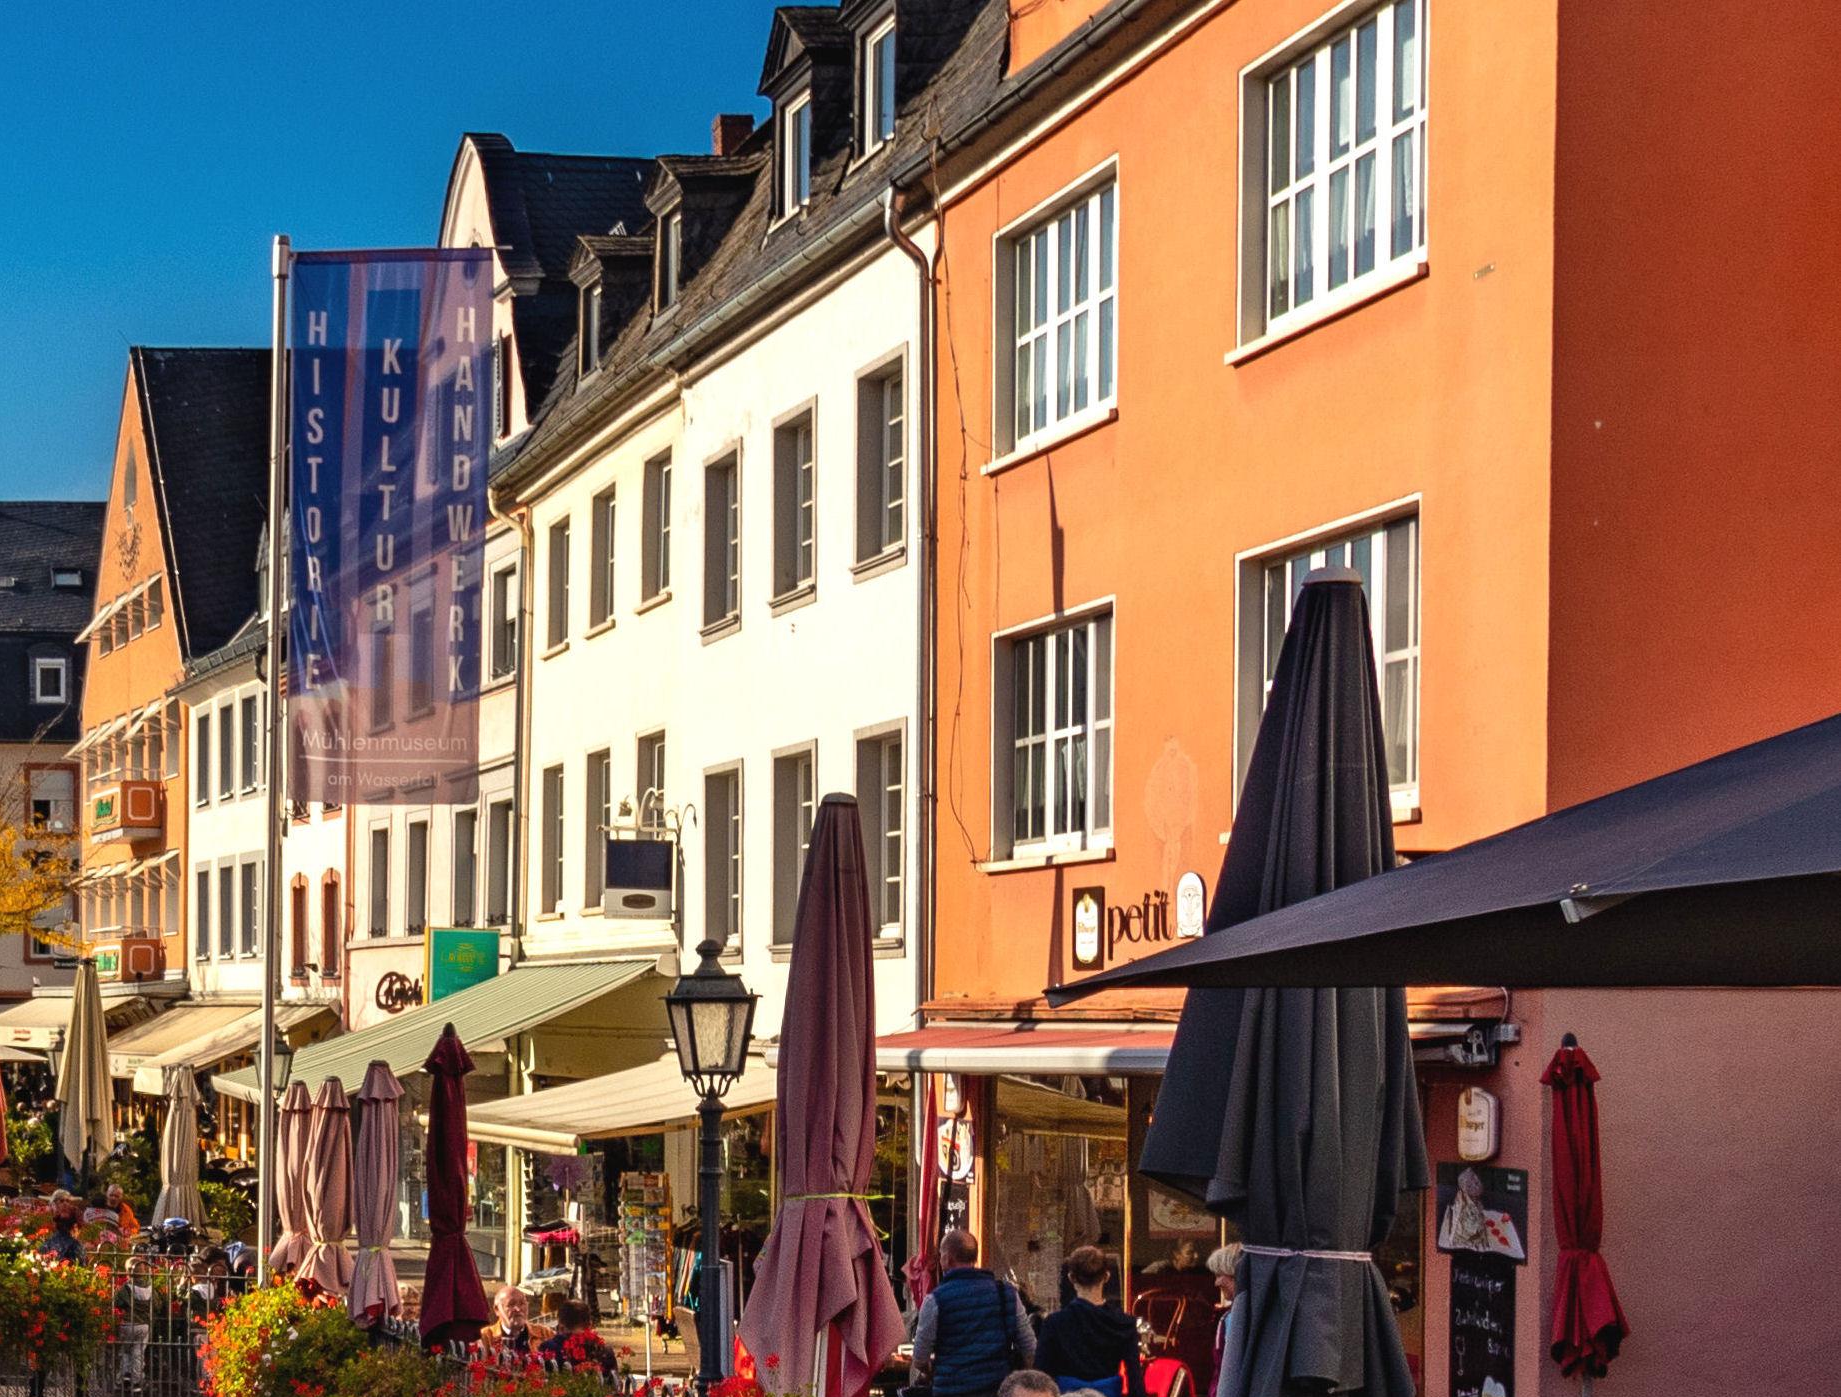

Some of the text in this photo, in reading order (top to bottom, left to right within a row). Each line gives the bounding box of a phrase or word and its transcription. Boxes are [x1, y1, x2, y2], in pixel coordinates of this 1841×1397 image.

[307, 311, 327, 690] HISTORIE
[377, 338, 403, 622] KULTUR
[447, 307, 476, 691] HANDWERK
[303, 730, 468, 752] Mühlenmuseum
[327, 771, 442, 787] am Wasserfall
[1107, 889, 1174, 961] petit
